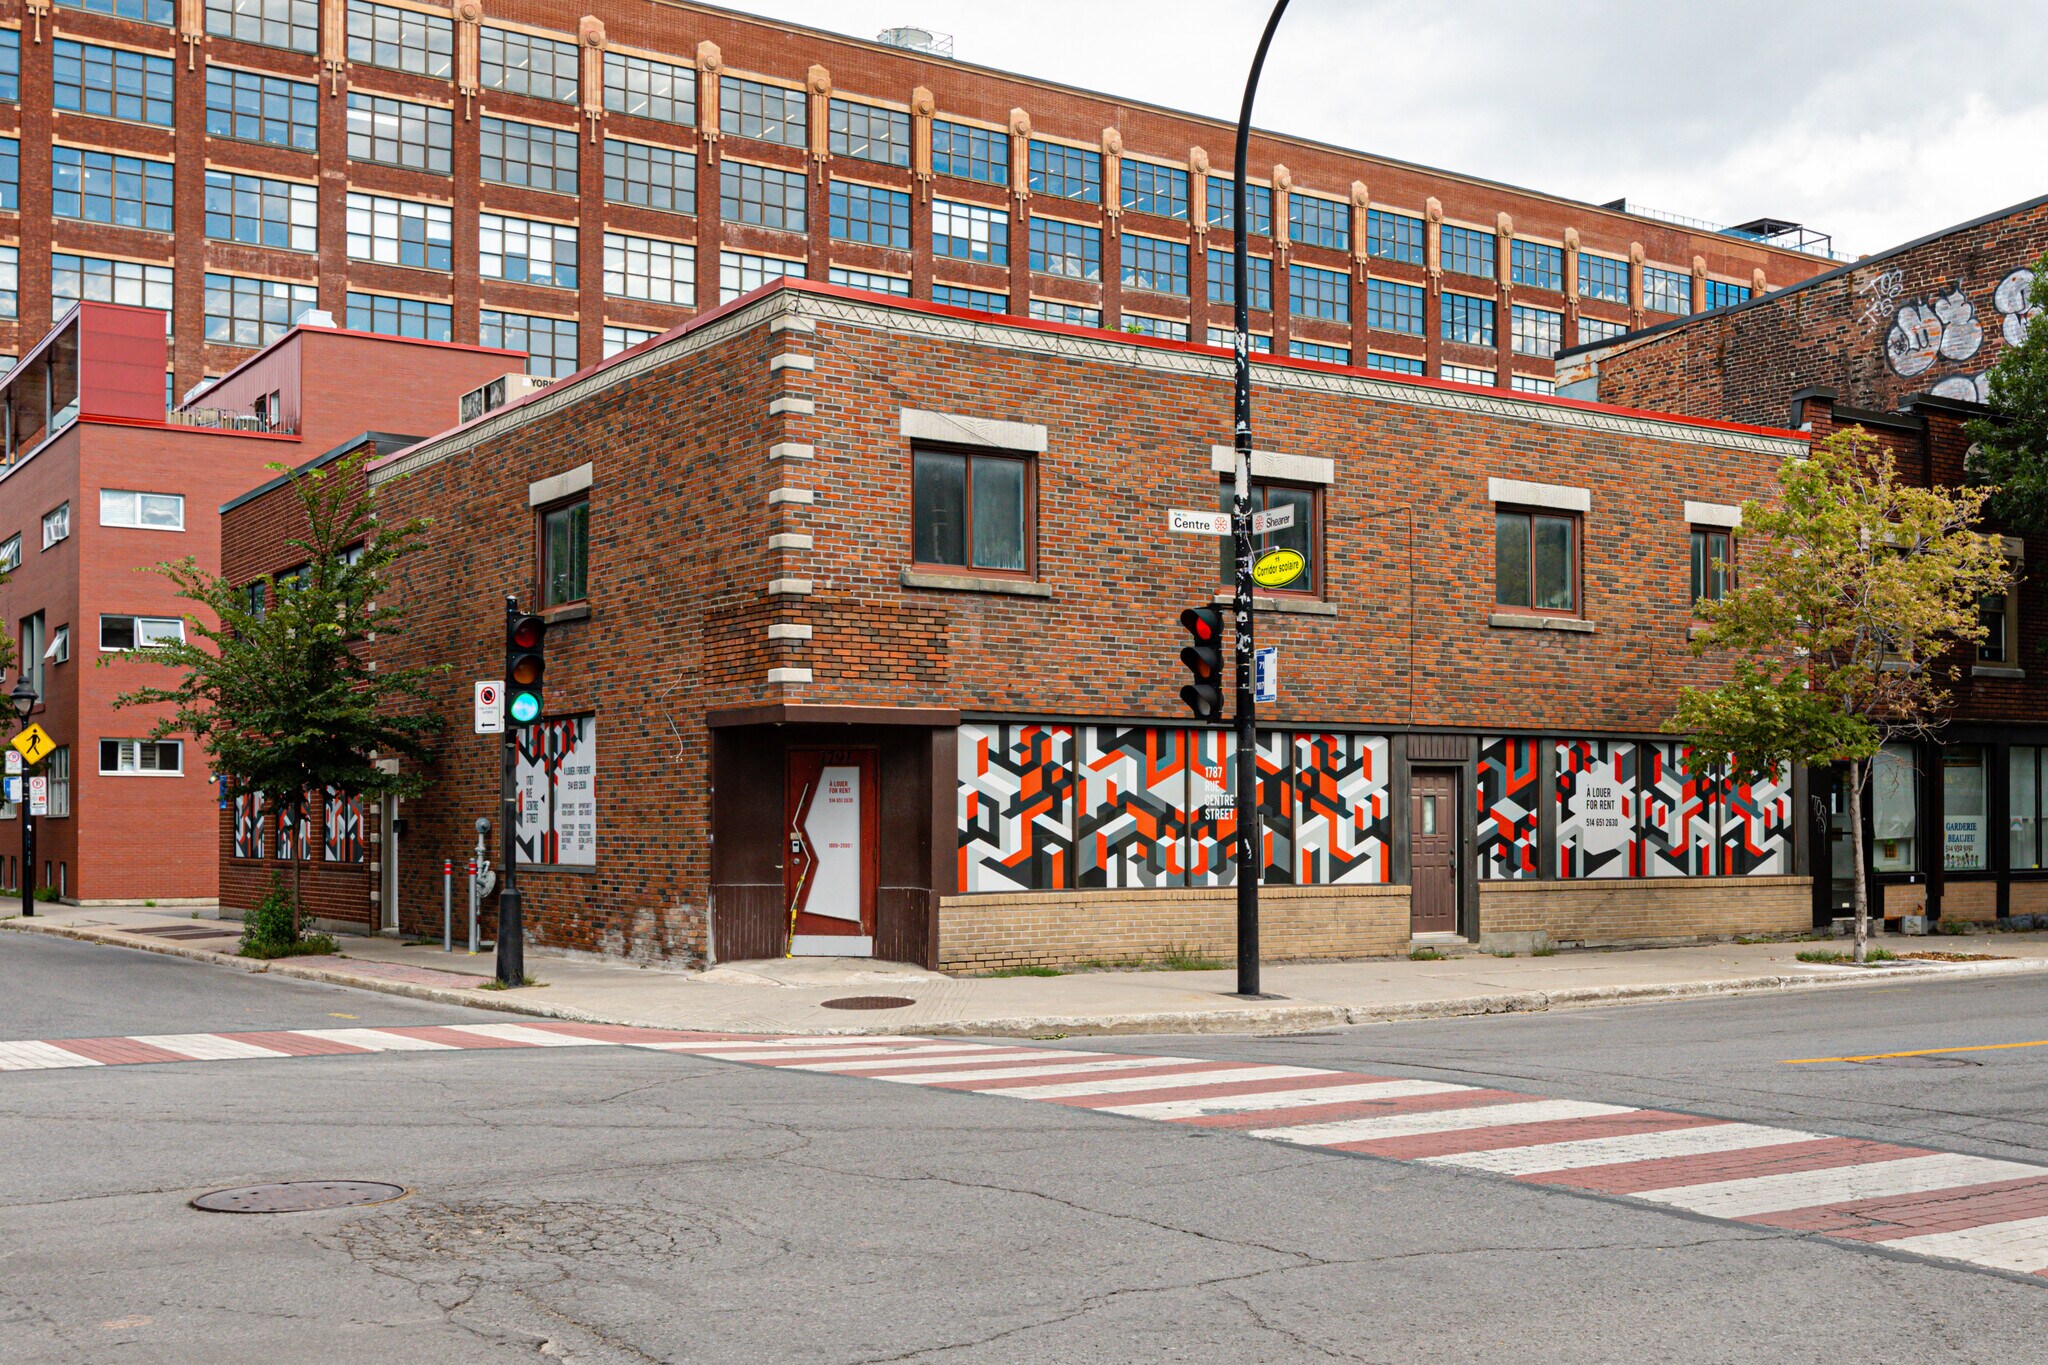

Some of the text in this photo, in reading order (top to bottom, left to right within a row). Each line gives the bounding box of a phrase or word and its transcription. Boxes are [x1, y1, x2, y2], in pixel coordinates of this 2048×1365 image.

[1174, 517, 1210, 530] Centre
[1266, 515, 1290, 528] Shearer
[1257, 560, 1299, 577] Corridor scolaire
[1205, 766, 1223, 778] 1787
[1205, 780, 1220, 791] RUE
[1586, 784, 1612, 798] À LOUER
[1205, 794, 1235, 806] CENTRE
[1586, 799, 1615, 810] FOR RENT
[1205, 808, 1234, 820] STREET
[1586, 818, 1619, 827] 514 651 2630
[1946, 822, 1977, 831] GARDERIE
[1948, 834, 1976, 843] BEAUJEU
